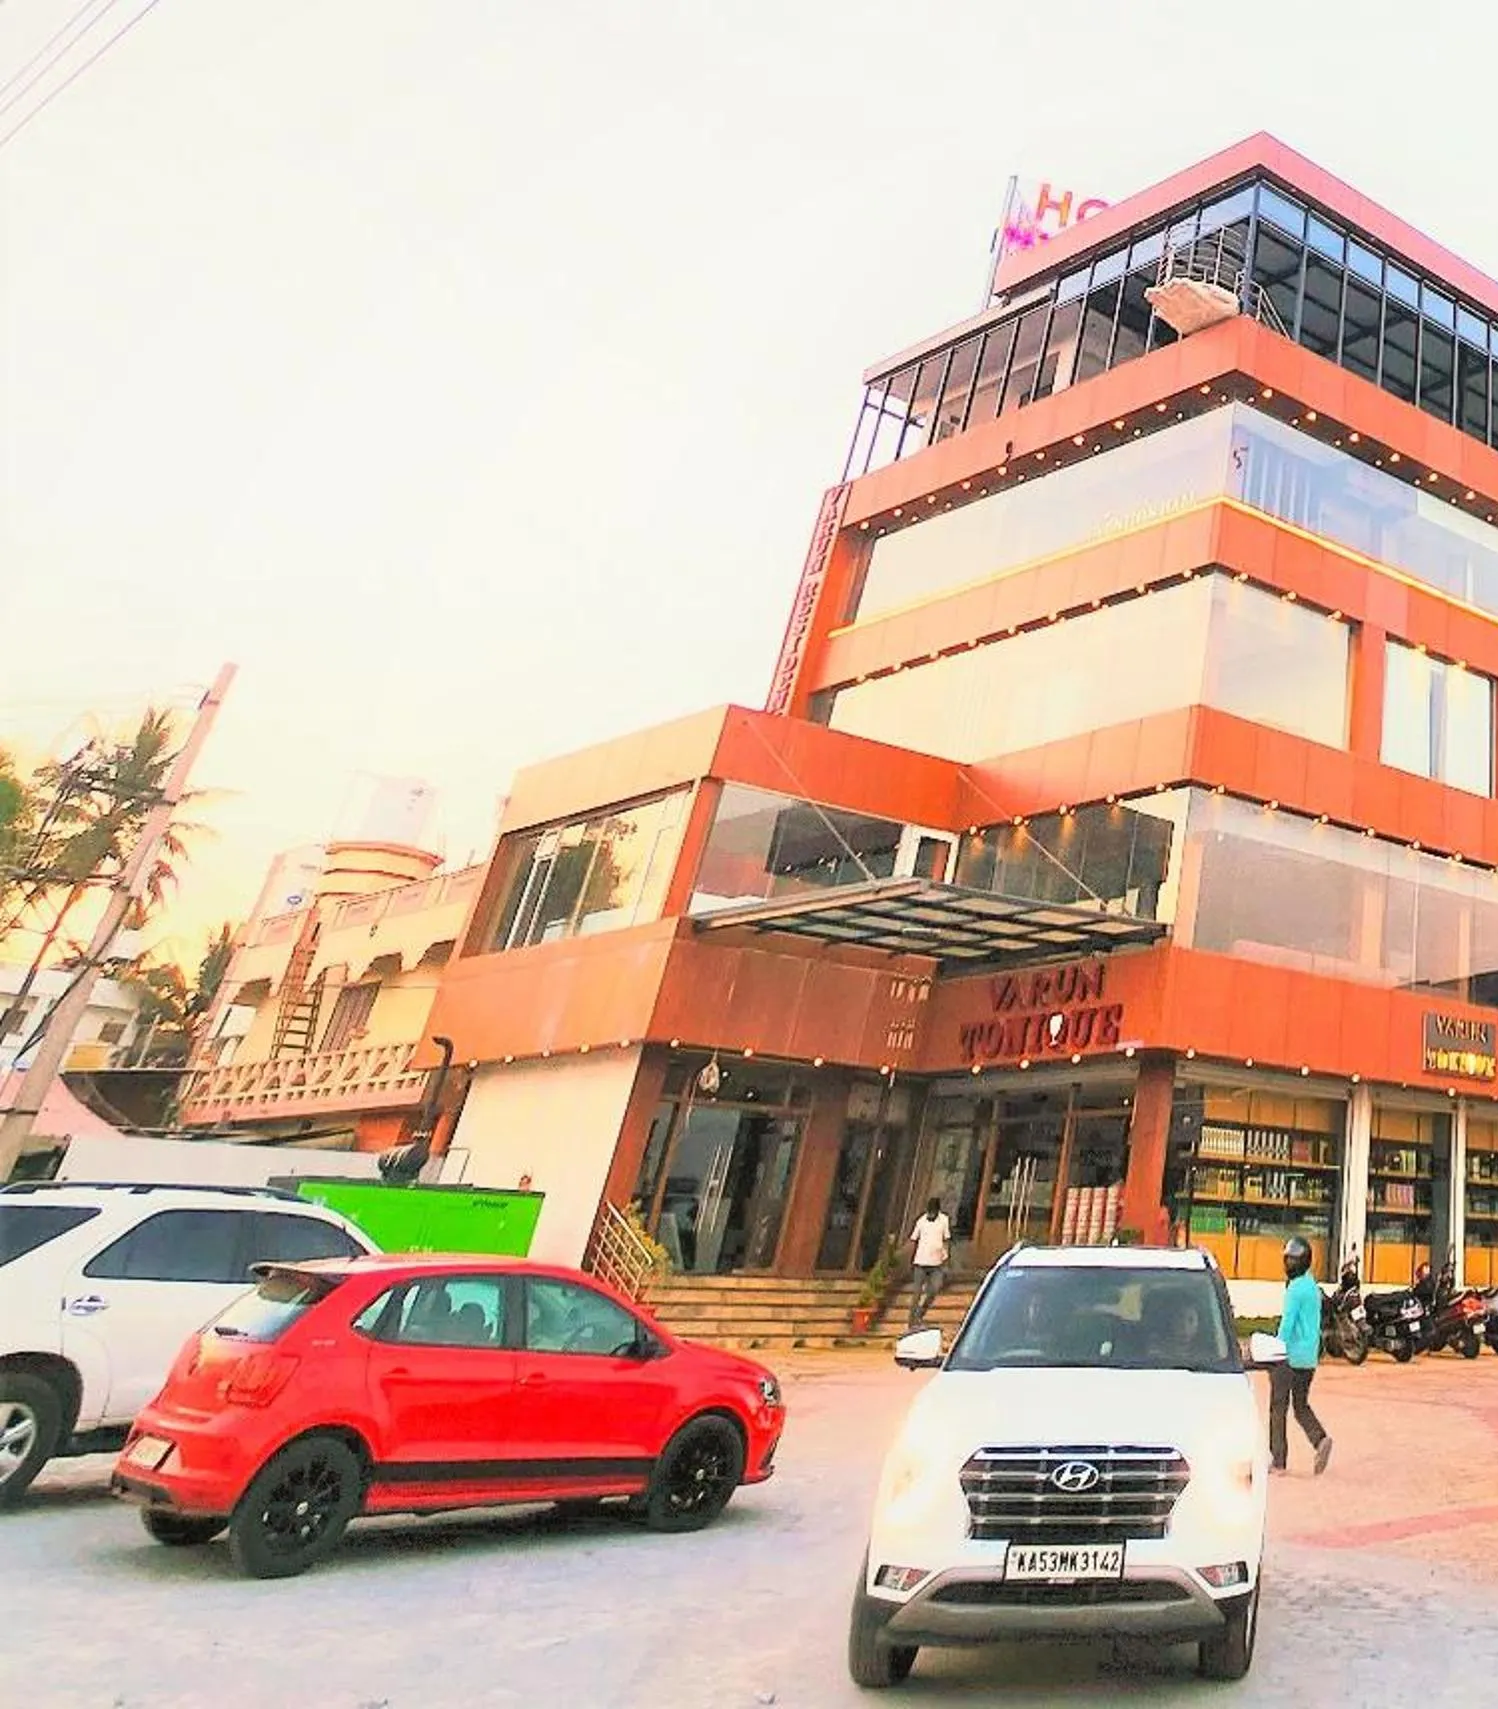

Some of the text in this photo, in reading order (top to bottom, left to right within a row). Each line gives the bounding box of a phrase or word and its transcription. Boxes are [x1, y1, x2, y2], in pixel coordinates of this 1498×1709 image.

[989, 962, 1105, 1013] VARUN
[958, 1003, 1124, 1062] TONIQUE
[1016, 1550, 1120, 1573] KA53MK3142
